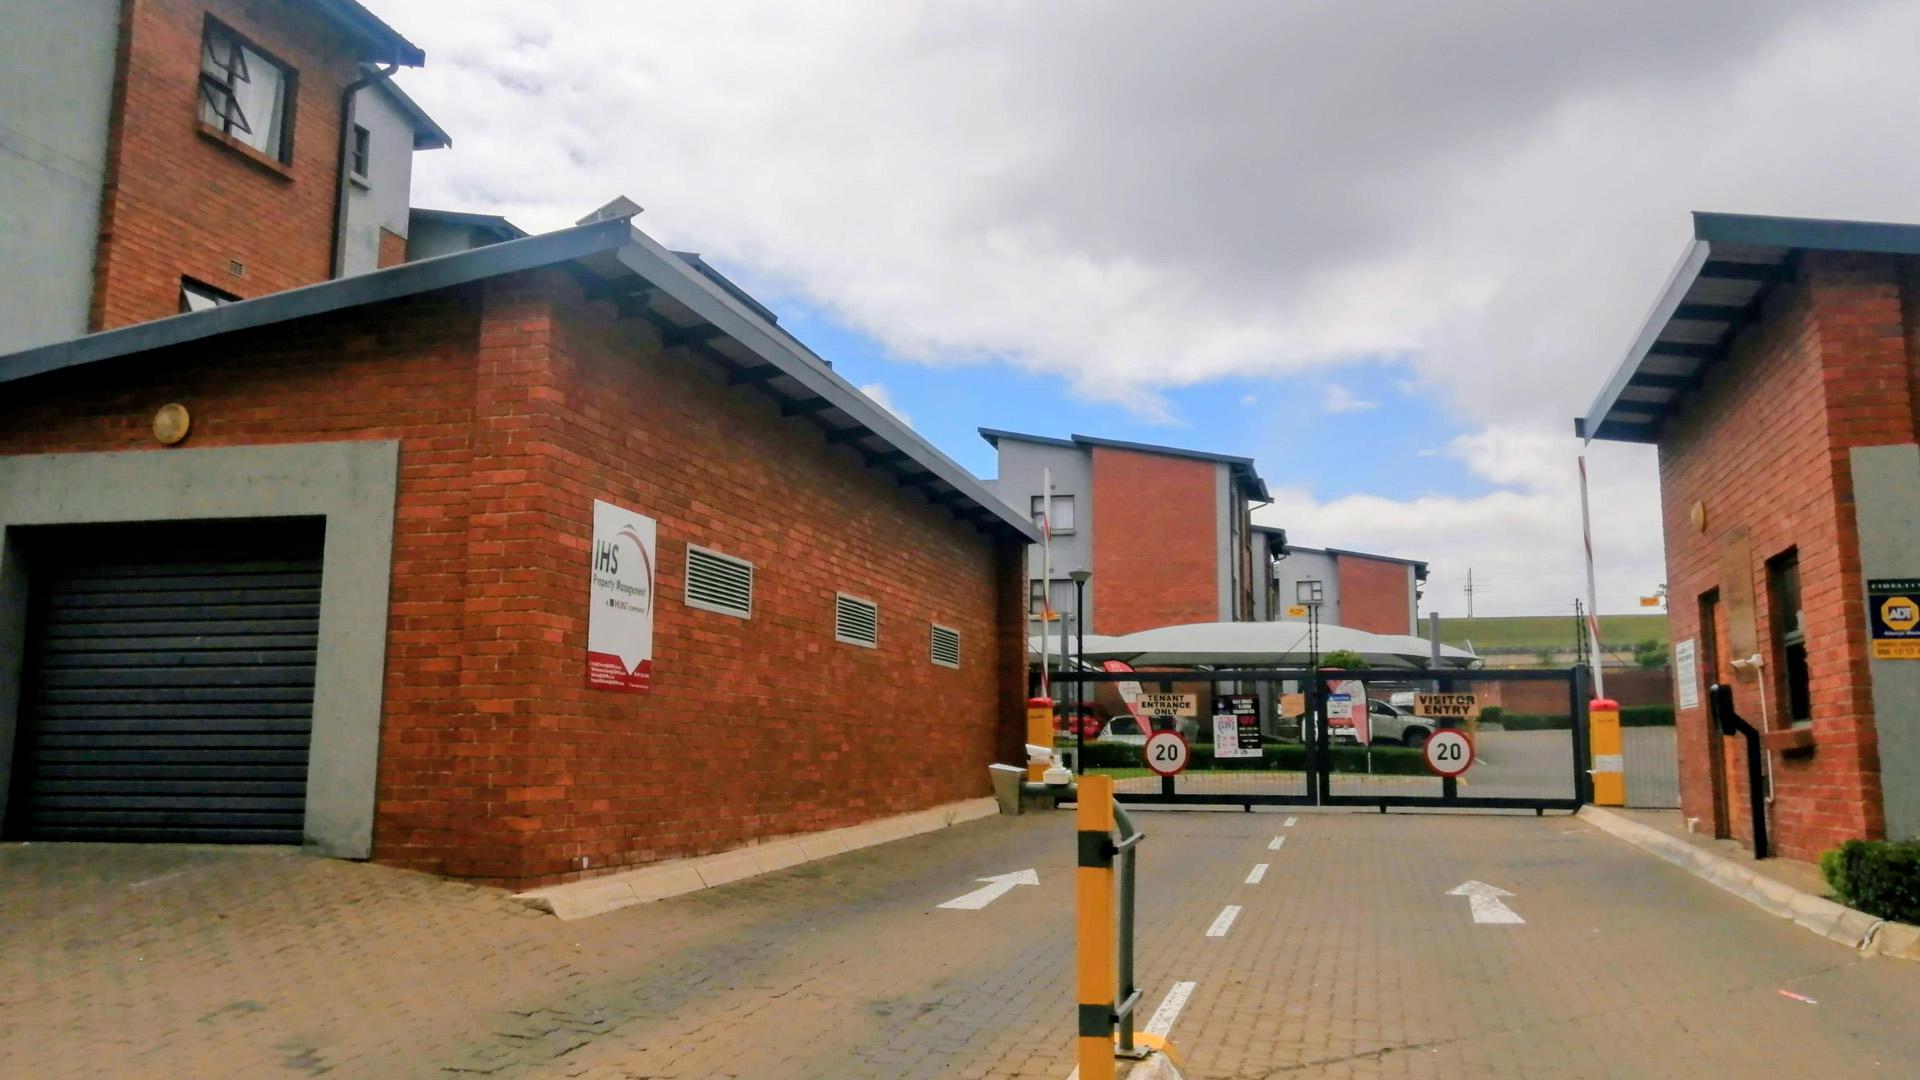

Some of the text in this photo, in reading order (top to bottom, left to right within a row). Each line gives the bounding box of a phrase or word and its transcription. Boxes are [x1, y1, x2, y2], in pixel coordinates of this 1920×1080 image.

[594, 539, 619, 575] IHS
[593, 573, 646, 596] Property Management
[1888, 607, 1912, 620] ADT
[1419, 695, 1475, 705] VISITOR
[1424, 705, 1471, 714] ENTRY
[1155, 744, 1178, 761] 20
[1437, 743, 1461, 760] 20
